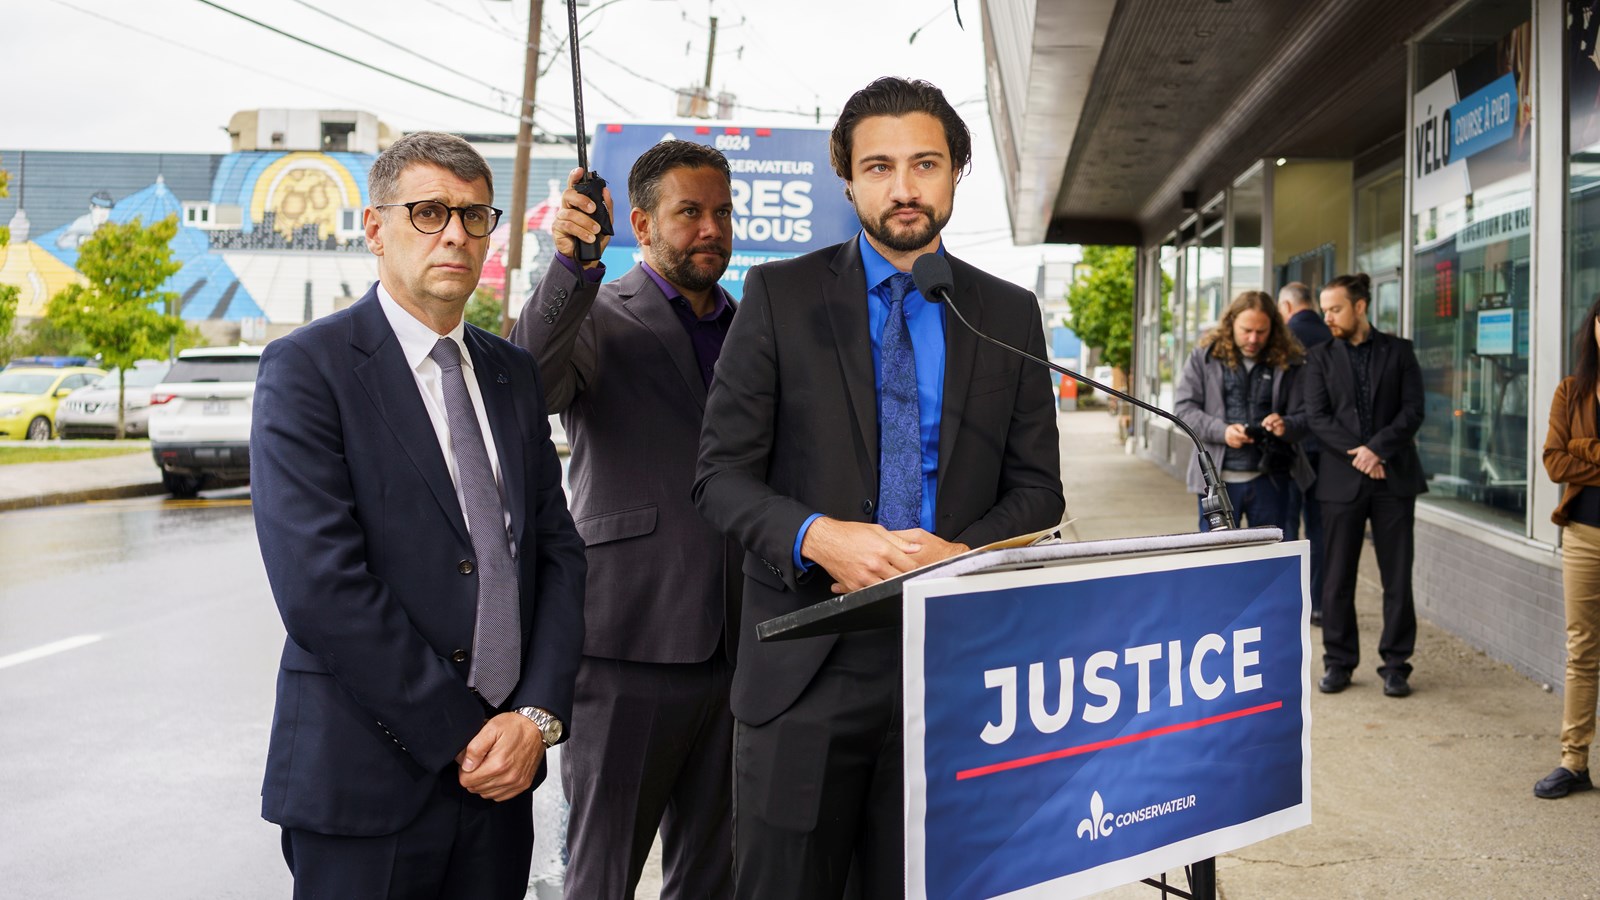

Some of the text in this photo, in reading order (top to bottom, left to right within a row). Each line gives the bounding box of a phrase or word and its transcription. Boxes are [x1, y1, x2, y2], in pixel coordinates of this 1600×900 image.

[1416, 104, 1452, 178] VÉLO
[1455, 92, 1510, 145] COURSE À PIED
[731, 217, 812, 243] NOUS
[979, 626, 1263, 745] JUSTICE
[1115, 794, 1196, 828] CONSERVATEUR
